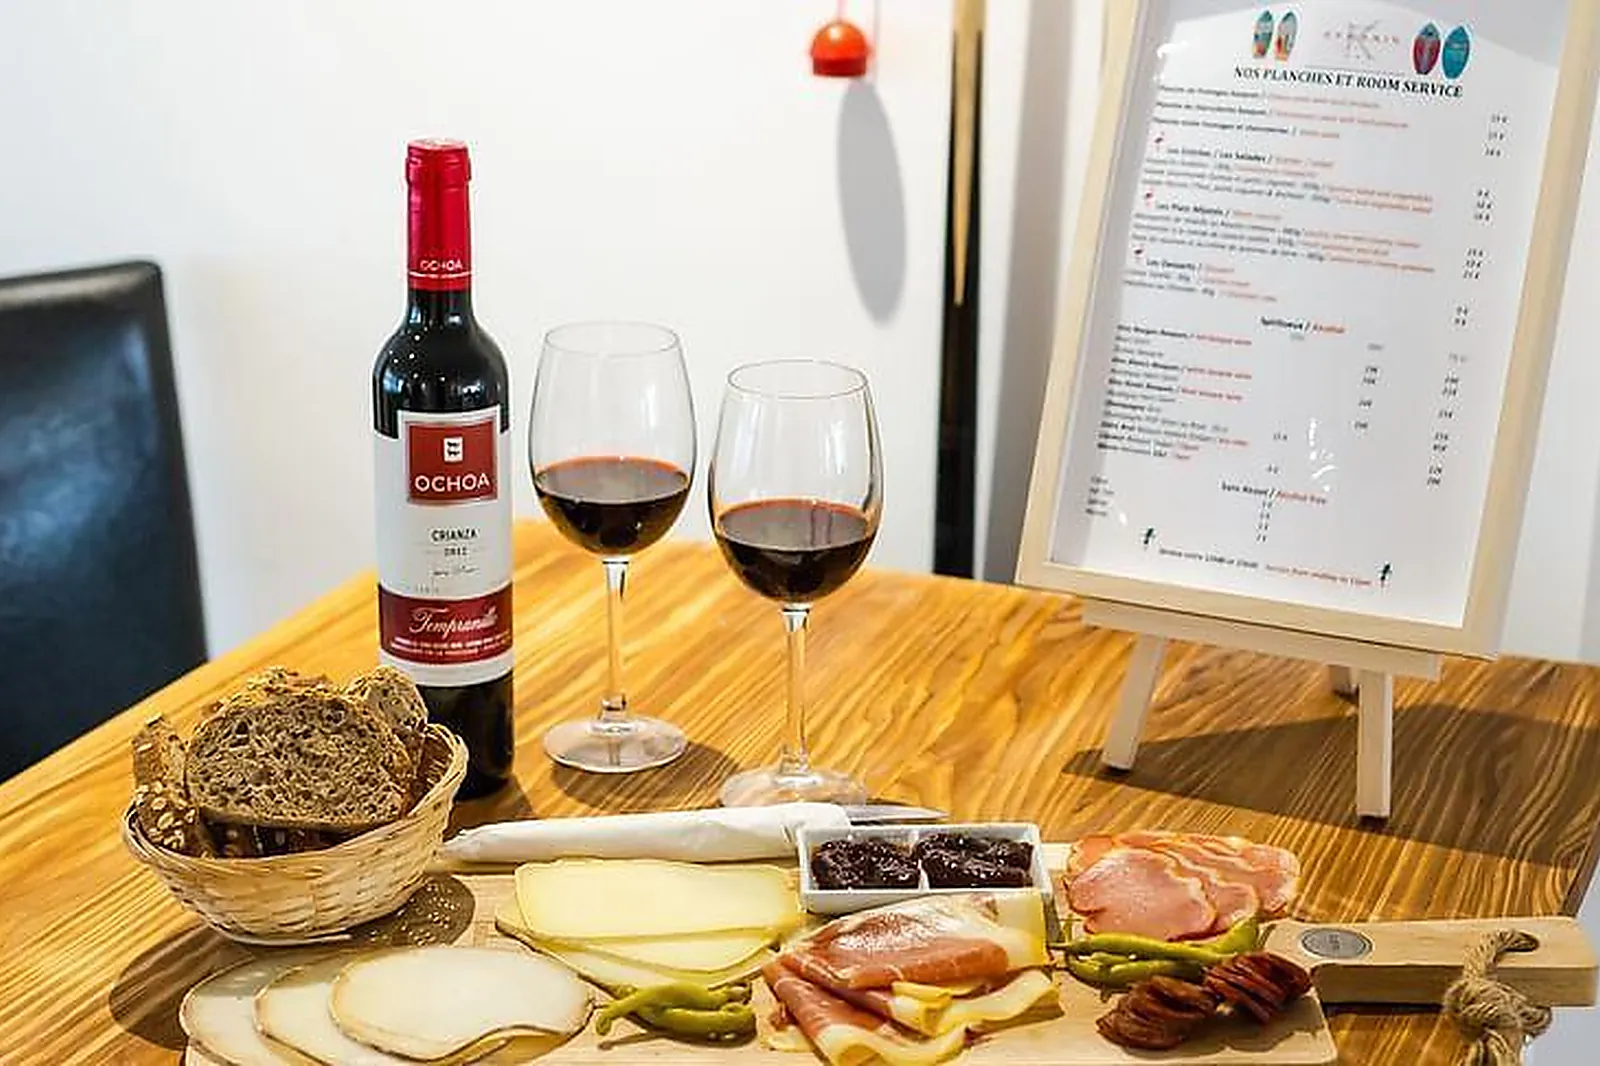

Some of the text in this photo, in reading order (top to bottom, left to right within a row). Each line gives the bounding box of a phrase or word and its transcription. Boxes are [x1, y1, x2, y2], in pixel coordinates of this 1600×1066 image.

[1234, 66, 1463, 98] NOS PLANCHES ET ROOM SERVICE
[414, 473, 490, 493] OCHOA
[431, 528, 478, 543] CRIANZA
